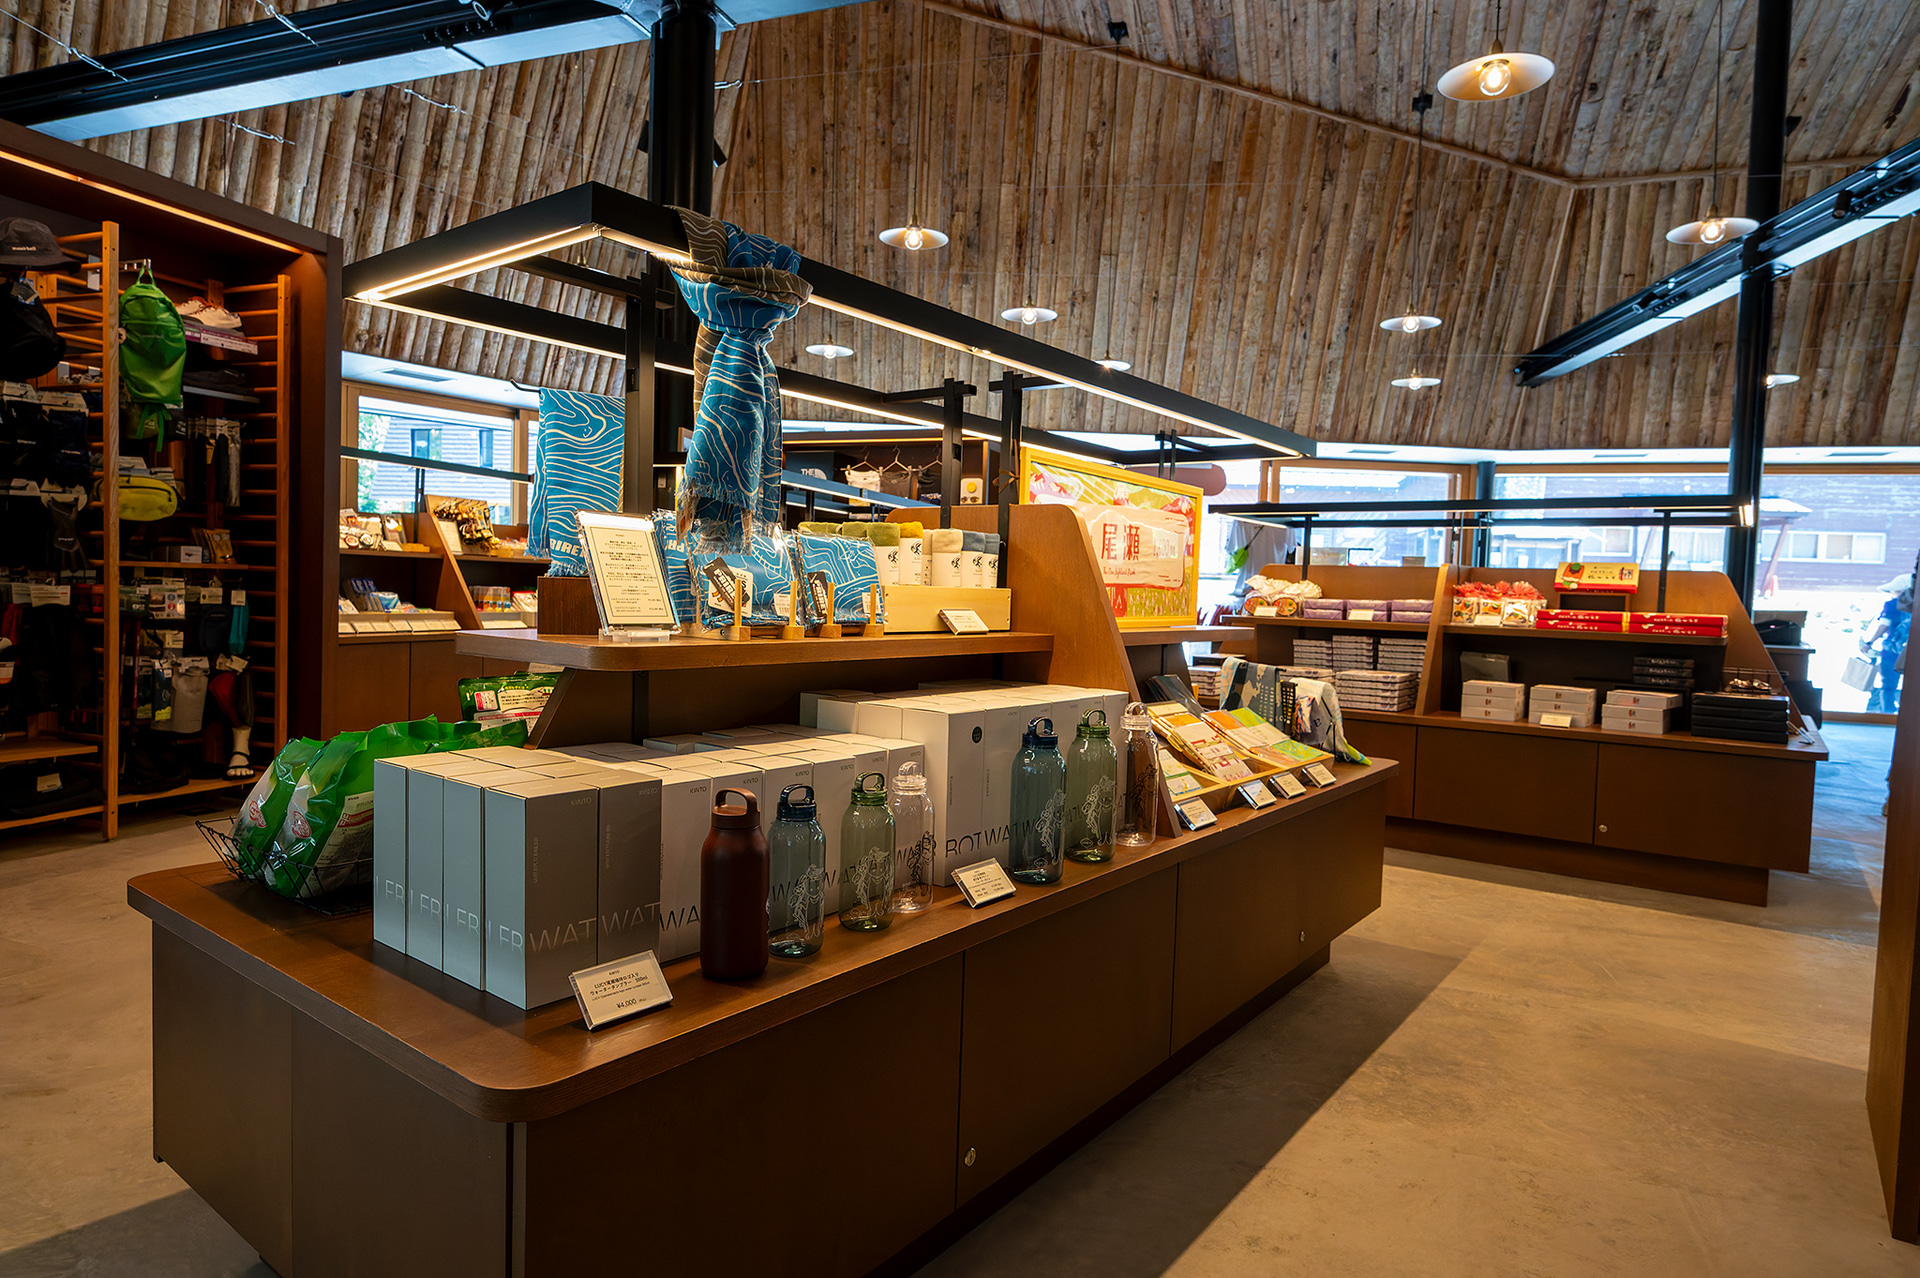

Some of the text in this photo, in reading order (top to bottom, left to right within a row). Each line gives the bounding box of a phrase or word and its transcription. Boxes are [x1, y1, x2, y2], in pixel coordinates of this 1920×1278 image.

[1101, 523, 1140, 561] 尾瀬
[570, 797, 593, 806] KINTO
[638, 787, 659, 796] KINTO
[689, 786, 708, 794] KINTO
[602, 901, 661, 936] WAT
[660, 904, 700, 931] WA
[529, 917, 597, 952] WAT
